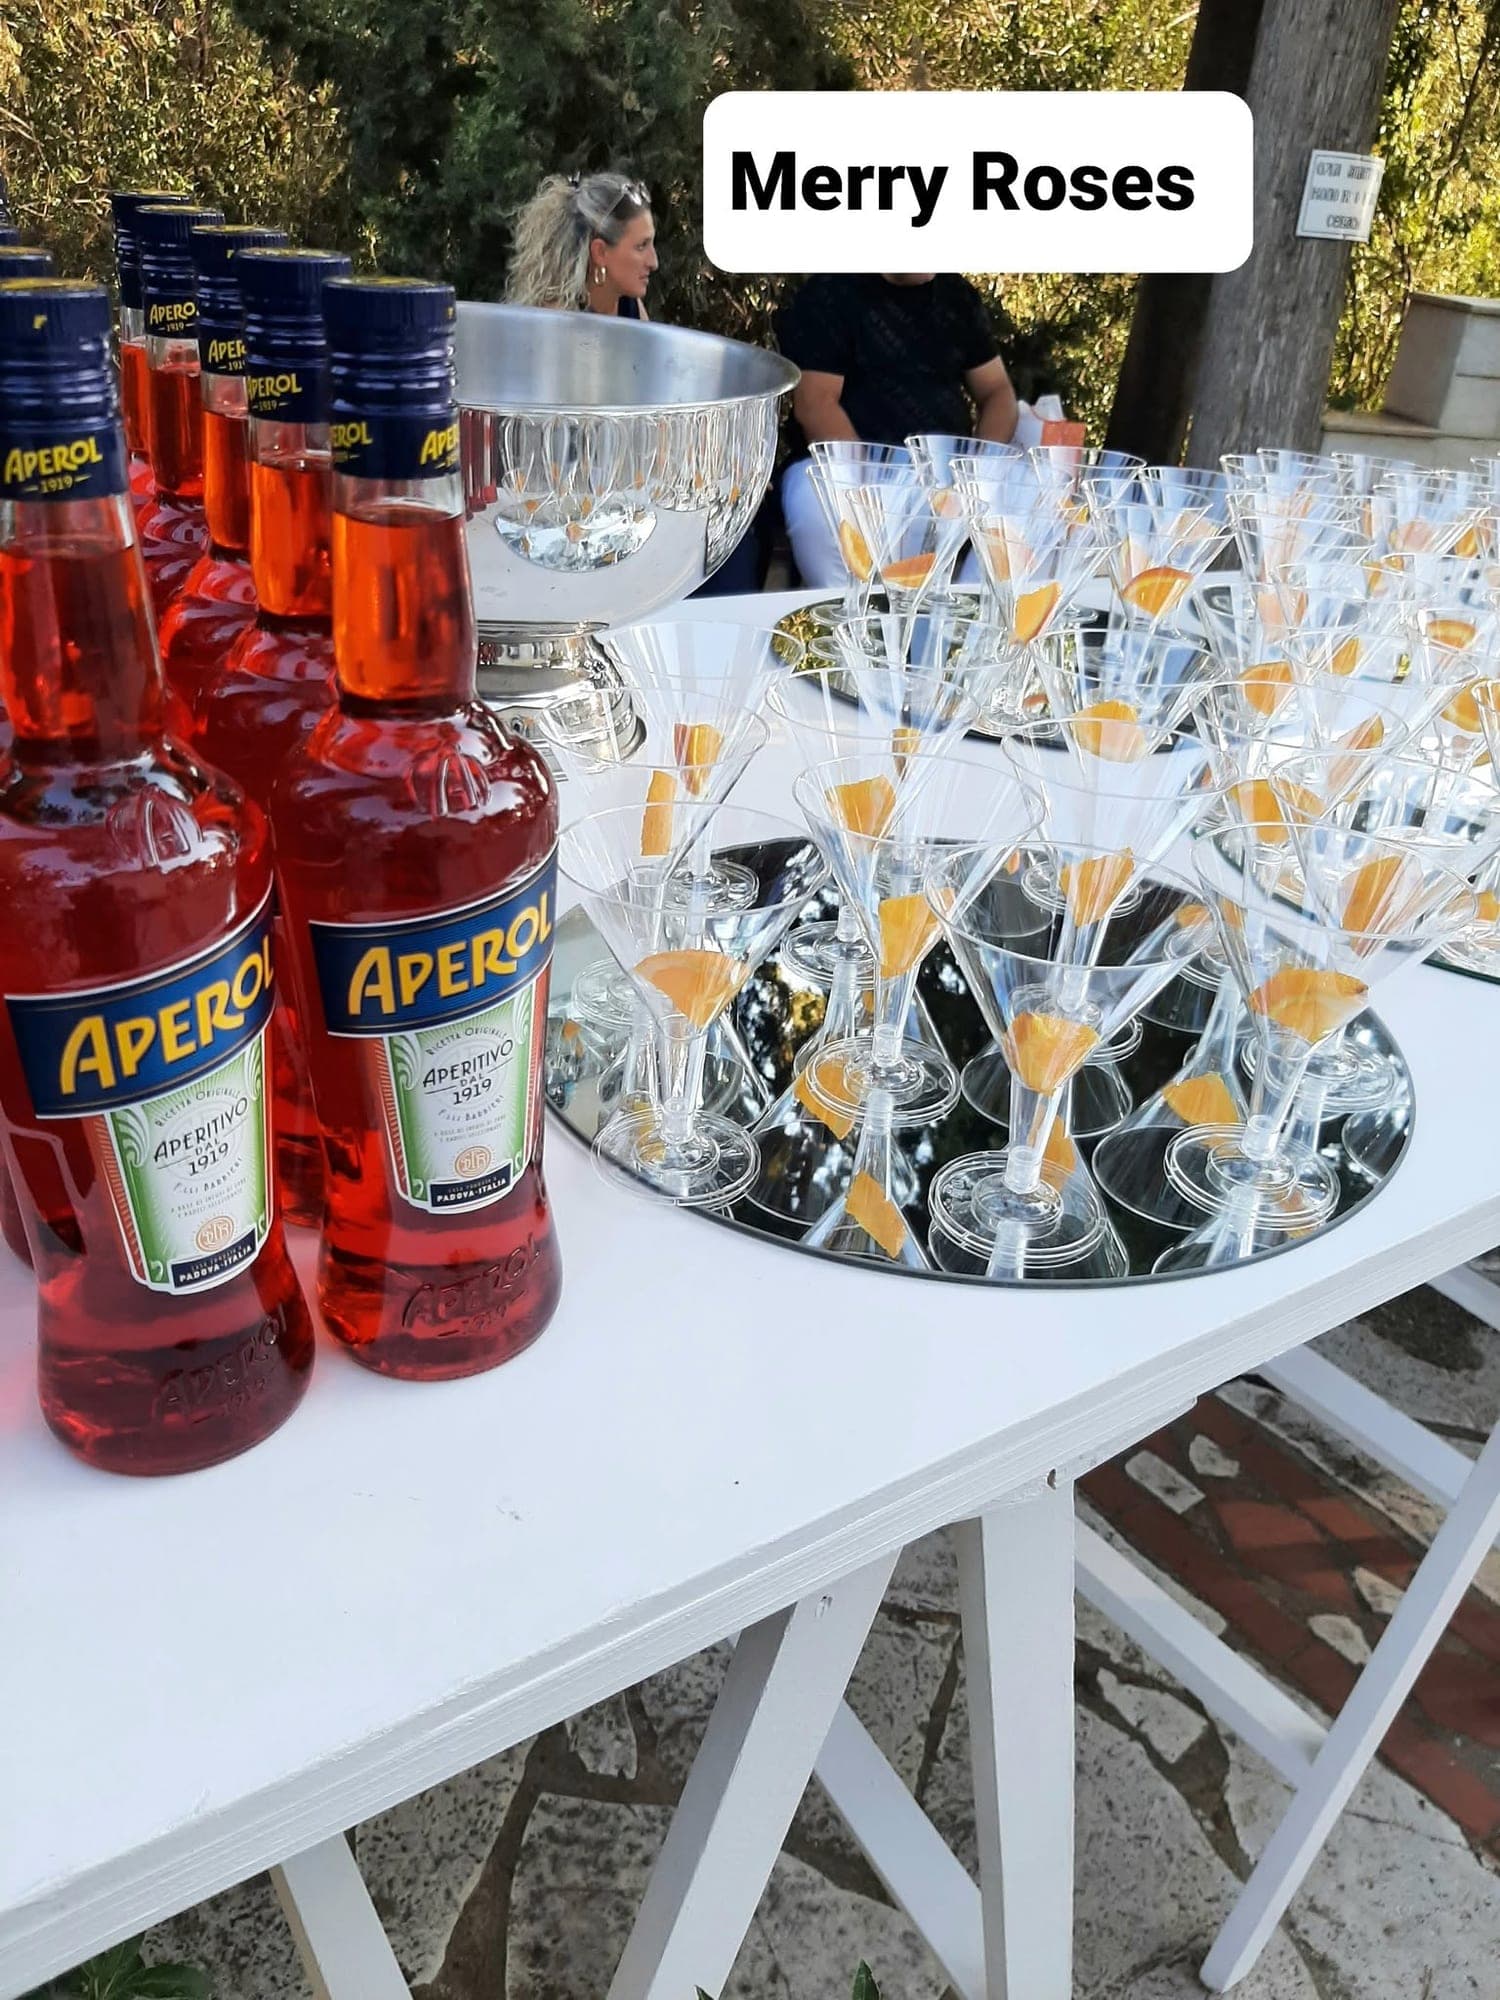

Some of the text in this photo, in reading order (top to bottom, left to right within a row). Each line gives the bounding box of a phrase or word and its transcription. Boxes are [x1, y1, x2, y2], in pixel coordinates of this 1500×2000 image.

[150, 302, 199, 325] APERO
[4, 436, 103, 485] APEROL
[41, 475, 73, 493] 1919
[348, 890, 552, 1016] APEROL
[59, 935, 275, 1095] APEROL
[423, 1039, 513, 1088] APERITIVO
[460, 1073, 484, 1087] DAL
[453, 1078, 492, 1105] 1919
[154, 1097, 248, 1163] APERITIVO
[195, 1138, 219, 1156] DAL
[188, 1142, 229, 1176] 1919
